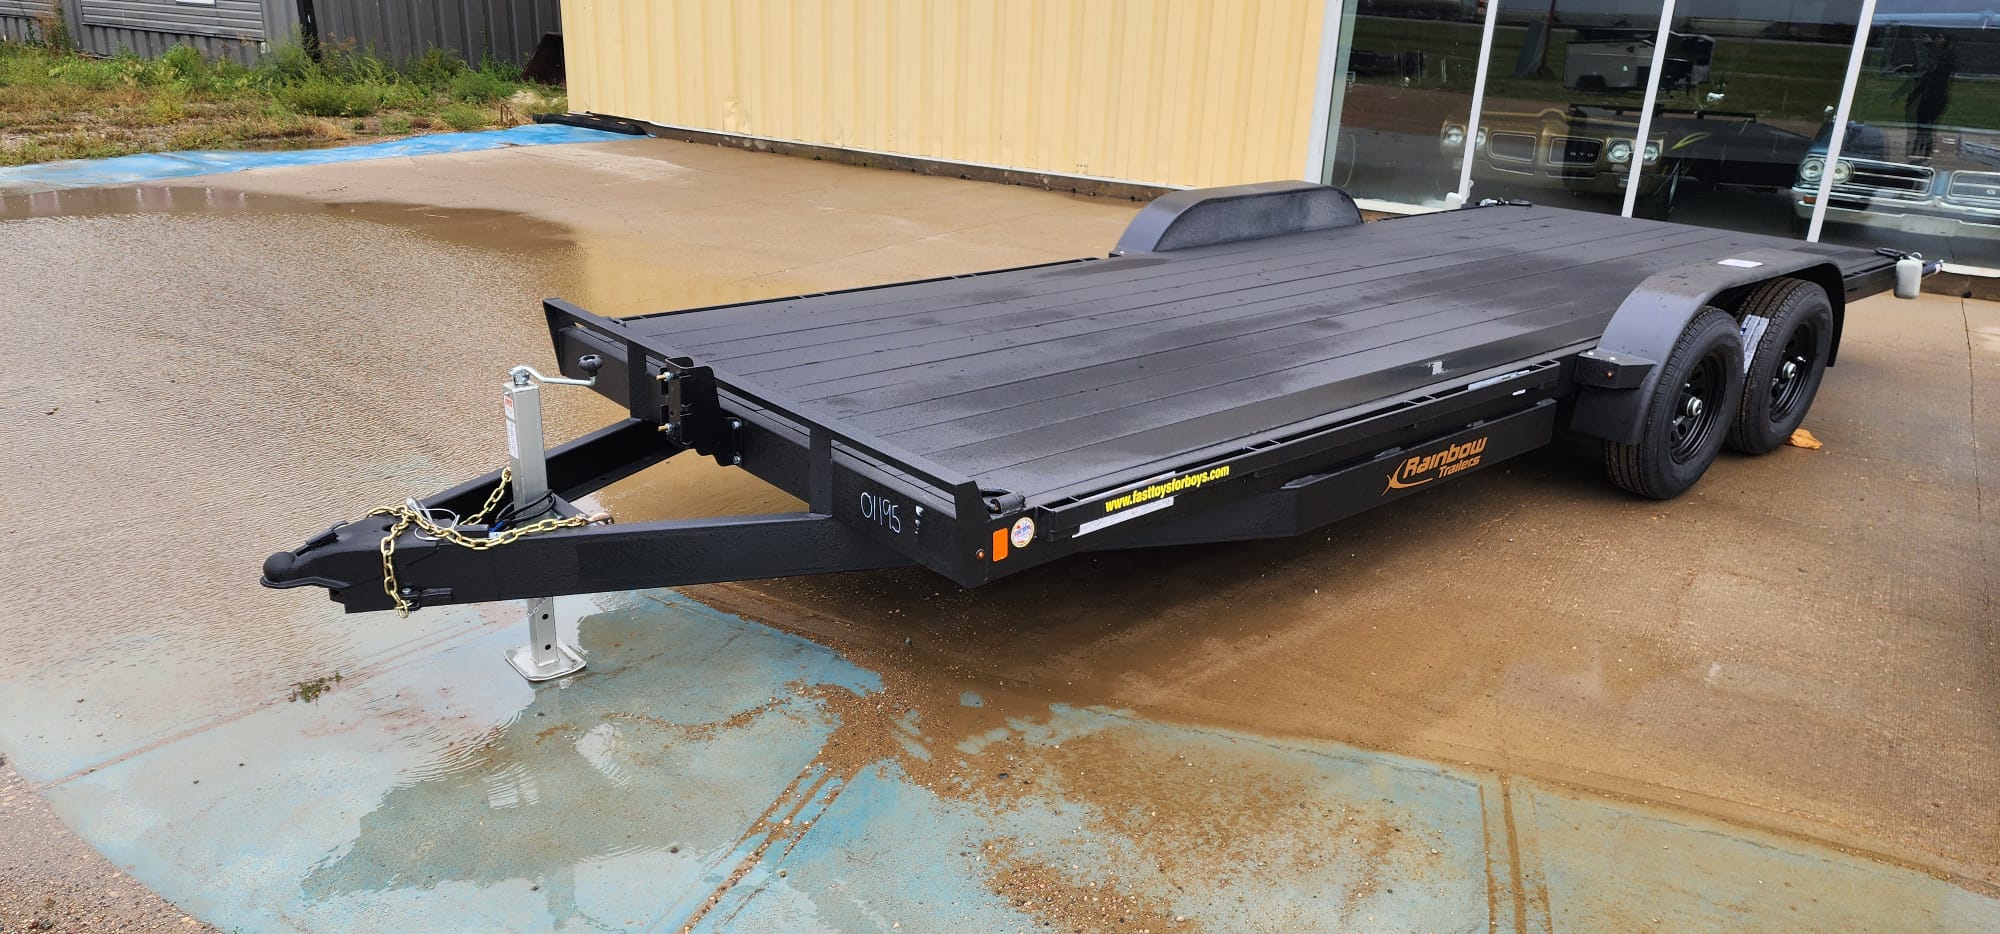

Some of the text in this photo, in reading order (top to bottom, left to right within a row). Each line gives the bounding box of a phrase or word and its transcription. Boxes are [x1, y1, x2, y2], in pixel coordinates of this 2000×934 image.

[1403, 437, 1488, 479] Rainbow
[1438, 456, 1481, 479] Trailers
[1105, 465, 1230, 512] www.fasttoysforboys.com
[860, 491, 901, 534] 01195
